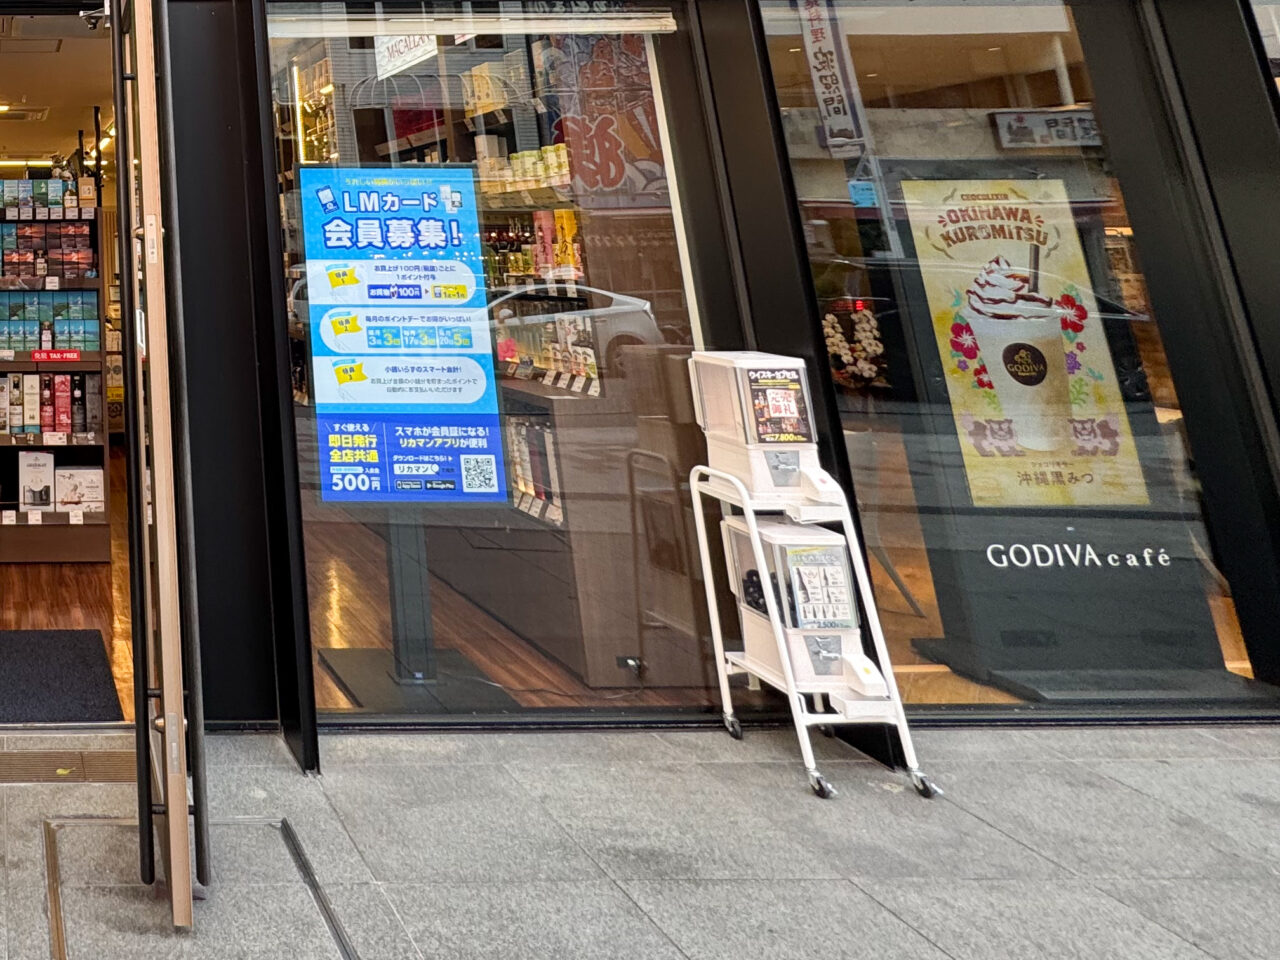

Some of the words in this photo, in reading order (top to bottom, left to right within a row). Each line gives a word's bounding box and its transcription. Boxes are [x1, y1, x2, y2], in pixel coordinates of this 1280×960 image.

[342, 191, 438, 213] LMカード
[946, 206, 1033, 224] OKINAWA
[322, 217, 462, 249] 会員募集!
[940, 224, 1048, 247] KUROMITSU
[1007, 364, 1045, 372] GODIVA
[329, 449, 379, 462] 全店共通
[1016, 471, 1094, 486] 沖縄黒みつ
[986, 544, 1101, 569] GODIVA
[1107, 547, 1171, 567] café
